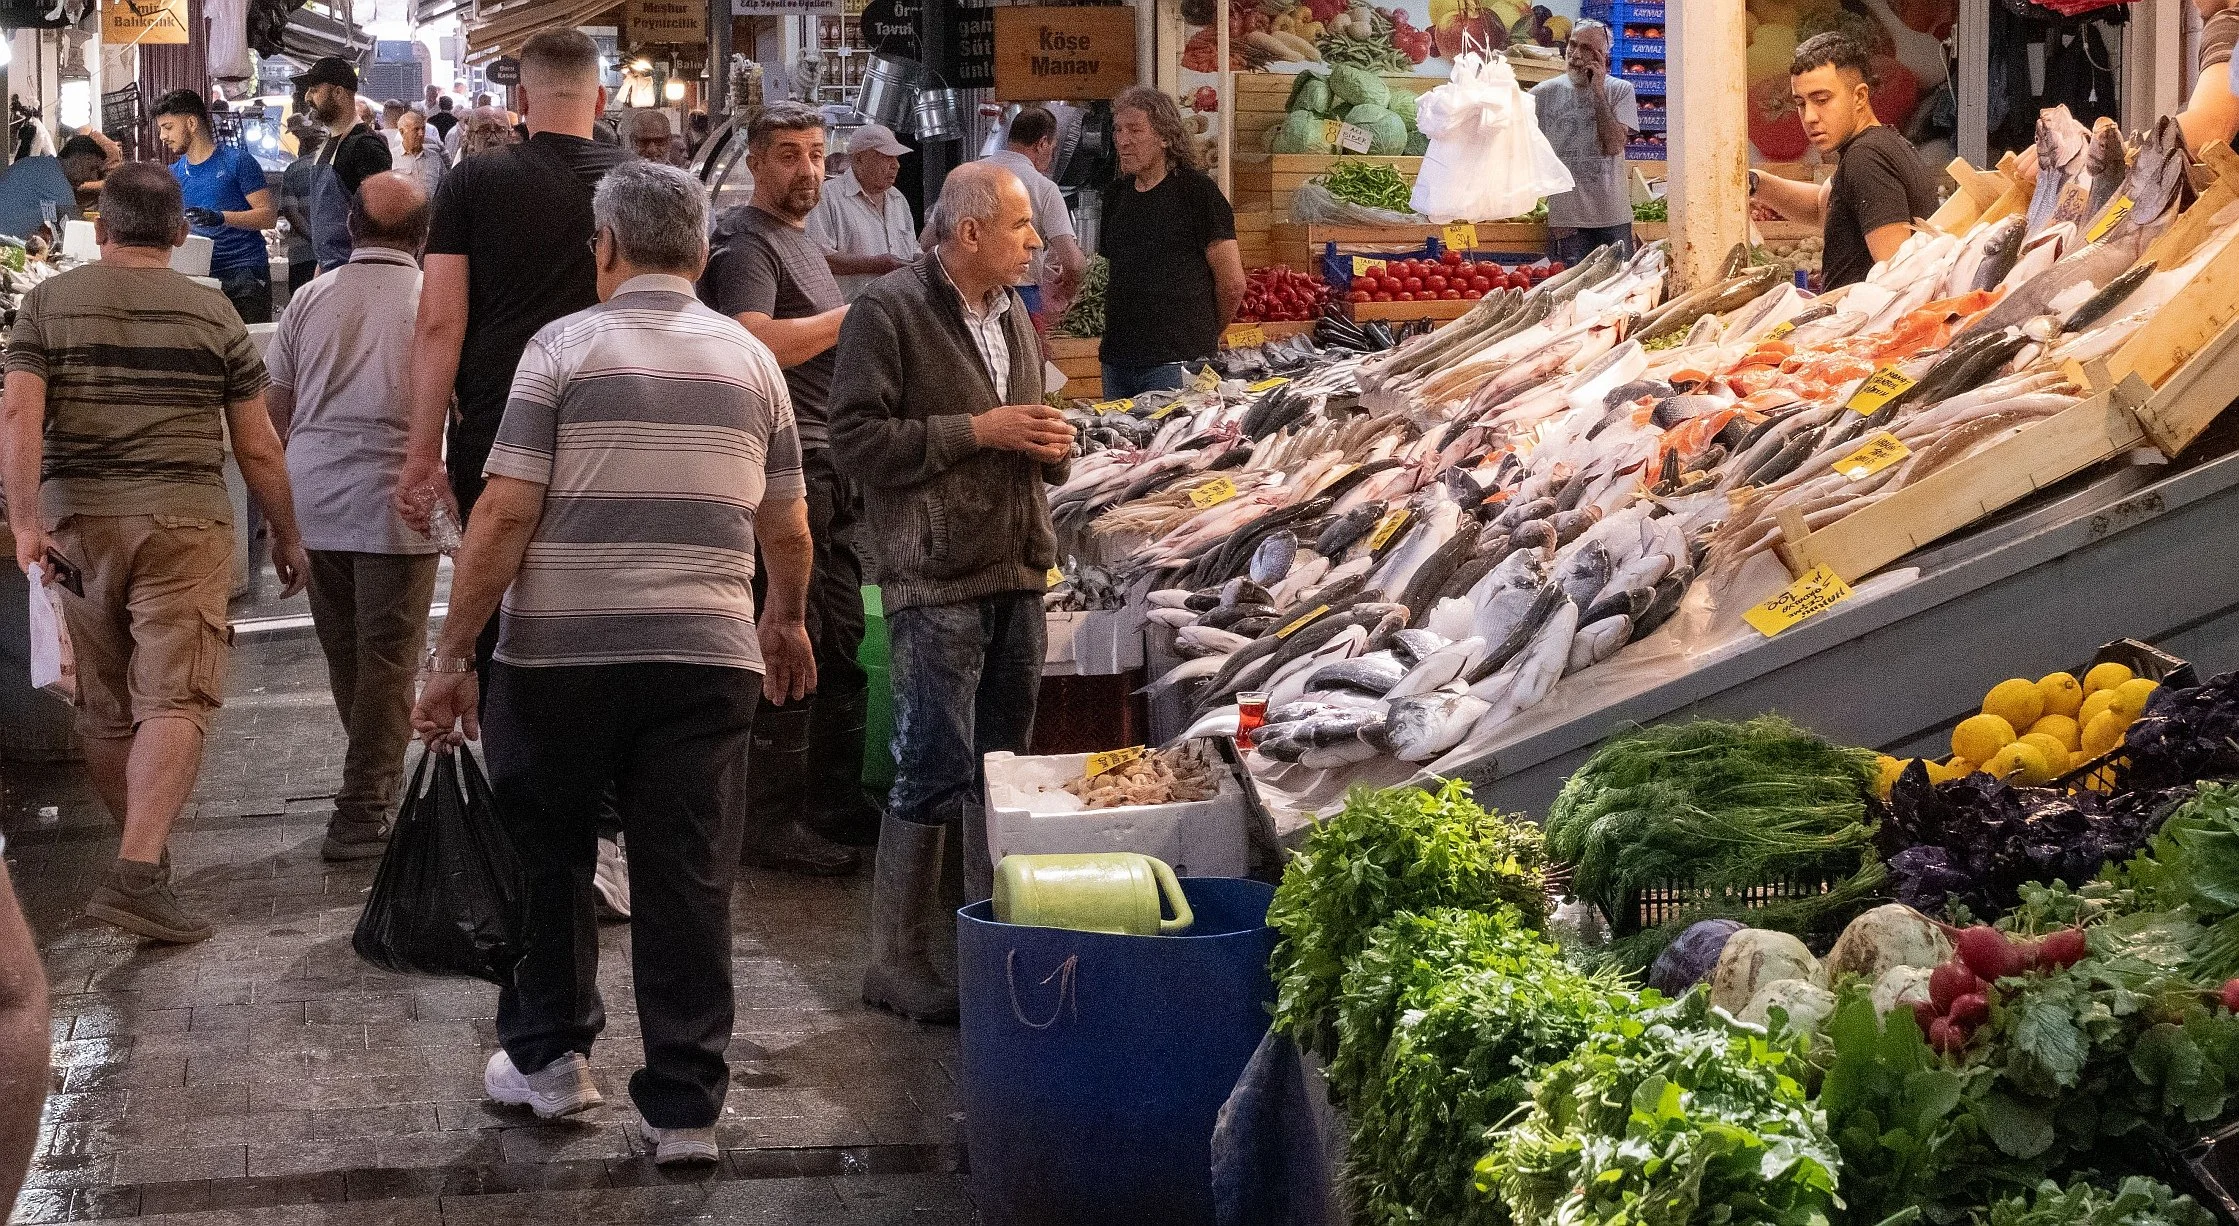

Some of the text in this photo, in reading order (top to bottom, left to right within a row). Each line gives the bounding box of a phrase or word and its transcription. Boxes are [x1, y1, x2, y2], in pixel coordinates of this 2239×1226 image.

[1633, 9, 1665, 17] KAYMAZ
[1631, 44, 1663, 53] KAYMAZ
[1030, 56, 1100, 76] Manav
[1638, 116, 1660, 125] YMAZ
